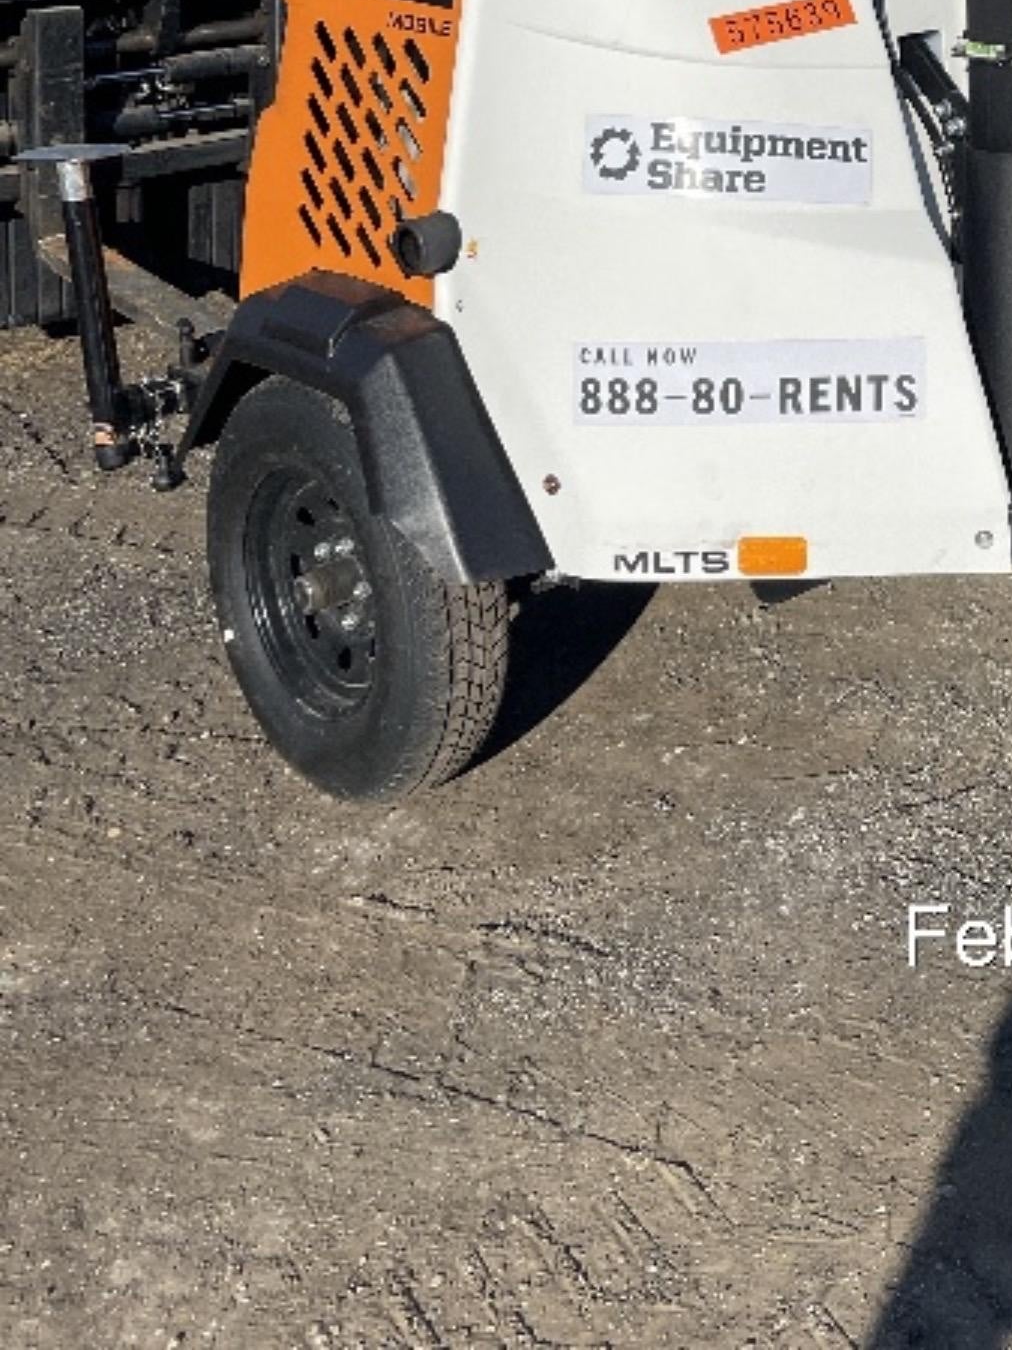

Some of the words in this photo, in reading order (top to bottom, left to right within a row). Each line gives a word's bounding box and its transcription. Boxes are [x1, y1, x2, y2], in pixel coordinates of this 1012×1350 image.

[650, 122, 868, 163] Equipment
[647, 158, 767, 193] Share
[579, 347, 633, 367] CALL
[647, 347, 698, 367] NOW
[580, 374, 918, 416] 888-80-RENTS
[614, 551, 730, 575] MLTS
